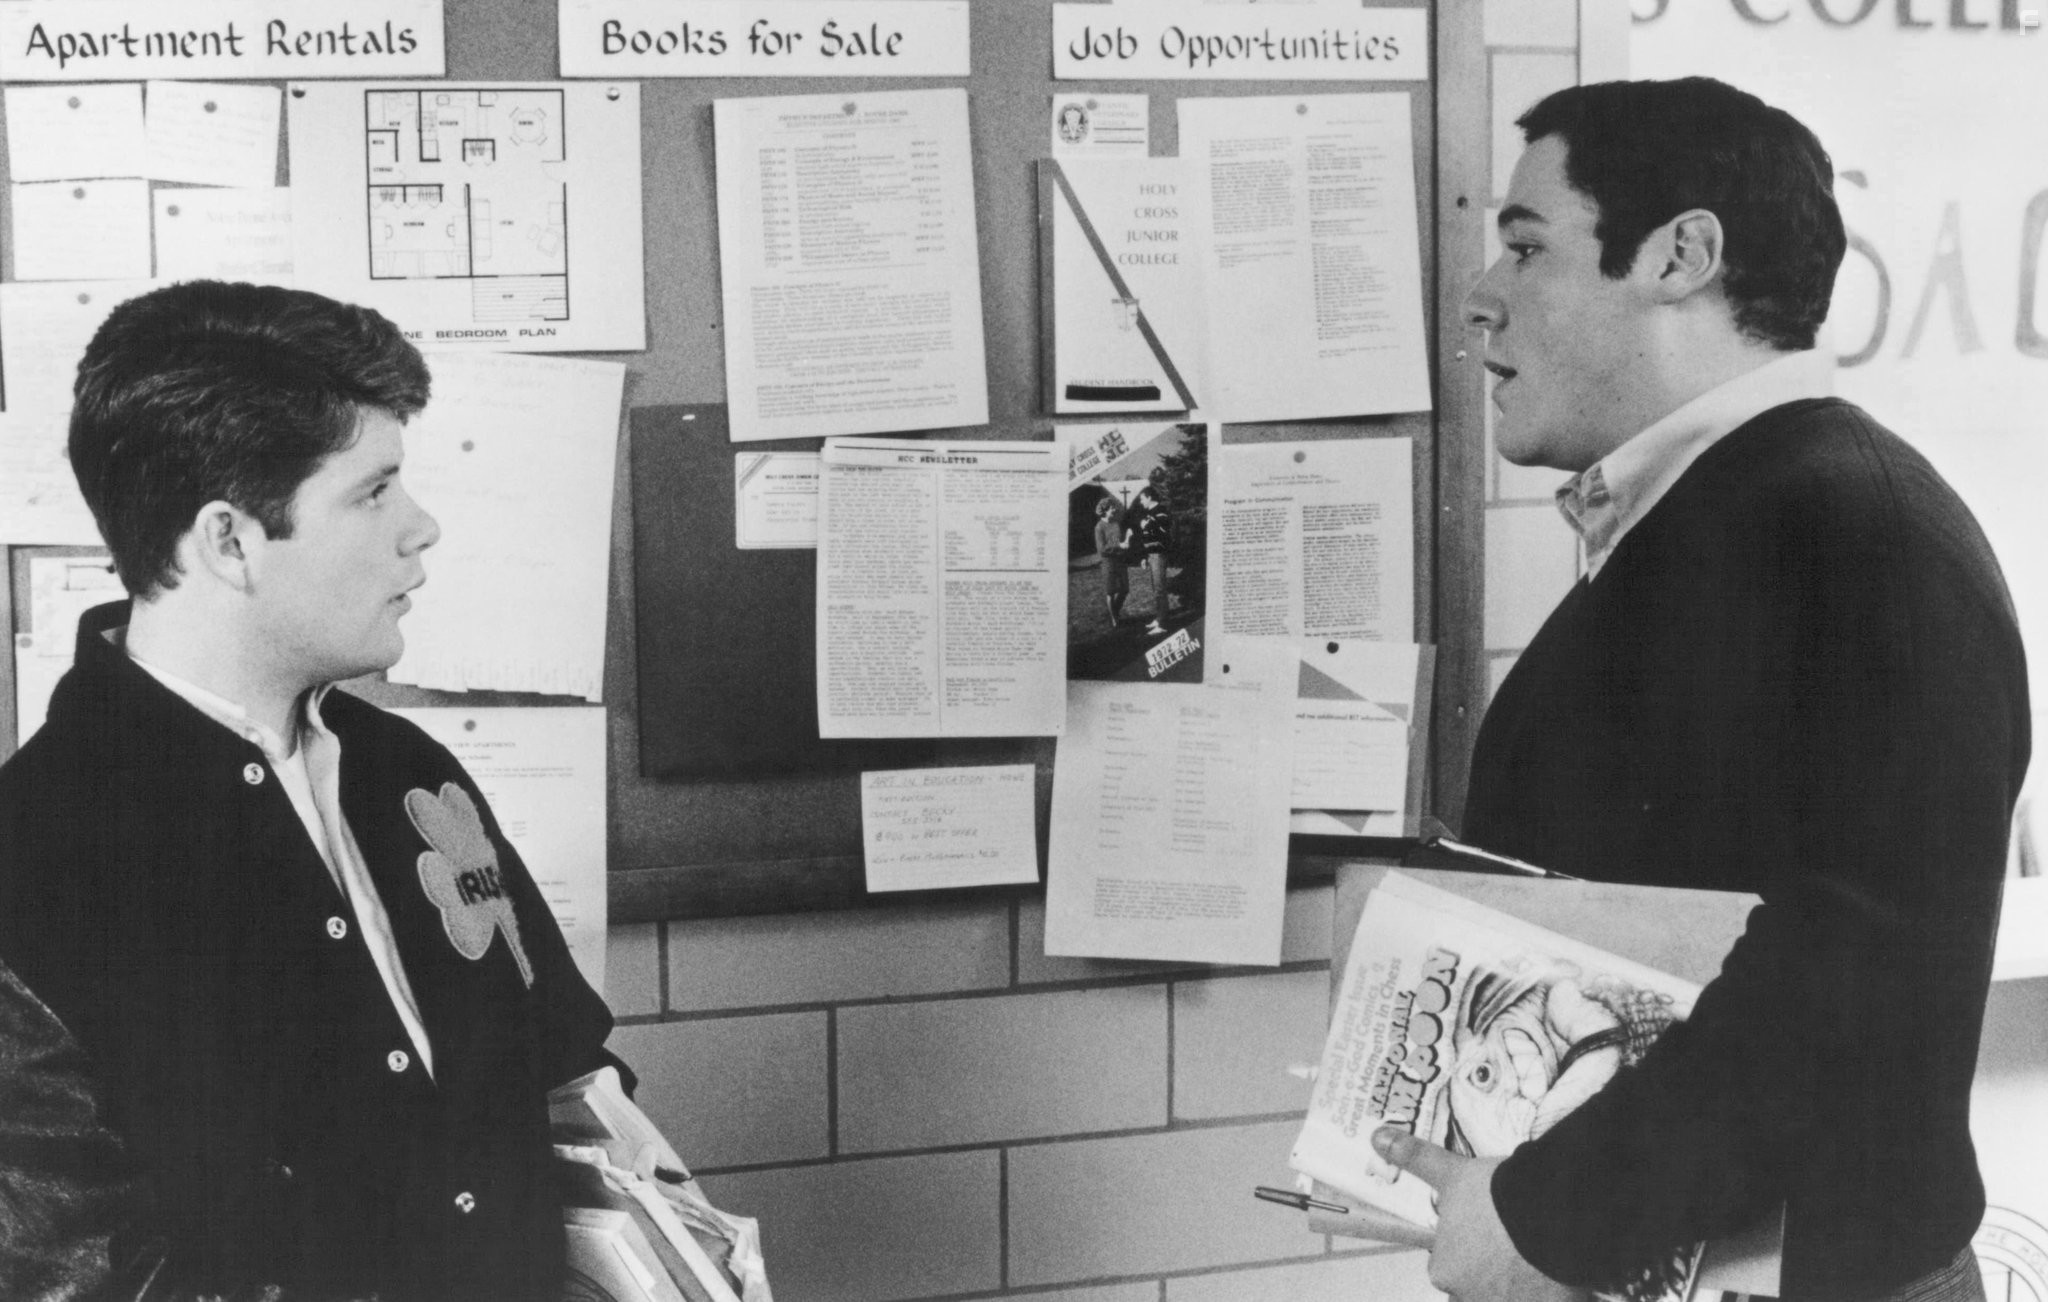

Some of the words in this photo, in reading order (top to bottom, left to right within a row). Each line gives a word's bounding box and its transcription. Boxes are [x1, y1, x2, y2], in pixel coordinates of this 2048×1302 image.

[26, 22, 244, 70] Apartment
[266, 18, 418, 57] Rentals
[602, 19, 728, 56] Books
[748, 18, 802, 56] for
[820, 20, 904, 57] Sale
[1069, 25, 1138, 60] Job
[1160, 26, 1400, 68] Opportunities
[1139, 184, 1177, 195] HOLY
[1134, 207, 1178, 219] CROSS
[1127, 230, 1178, 243] JUNIOR
[1118, 253, 1179, 265] COLLEGE
[403, 330, 424, 339] NE
[435, 328, 508, 339] BEDROOM
[518, 328, 557, 338] PLAN
[1148, 637, 1201, 679] BULLETIN
[1376, 954, 1403, 1001] Chess
[1353, 983, 1381, 1037] Comics
[1374, 1001, 1390, 1018] in
[1354, 1021, 1387, 1093] Moments
[1364, 987, 1418, 1119] NATIONAL
[1316, 1052, 1345, 1111] Special
[1341, 1095, 1366, 1139] Great
